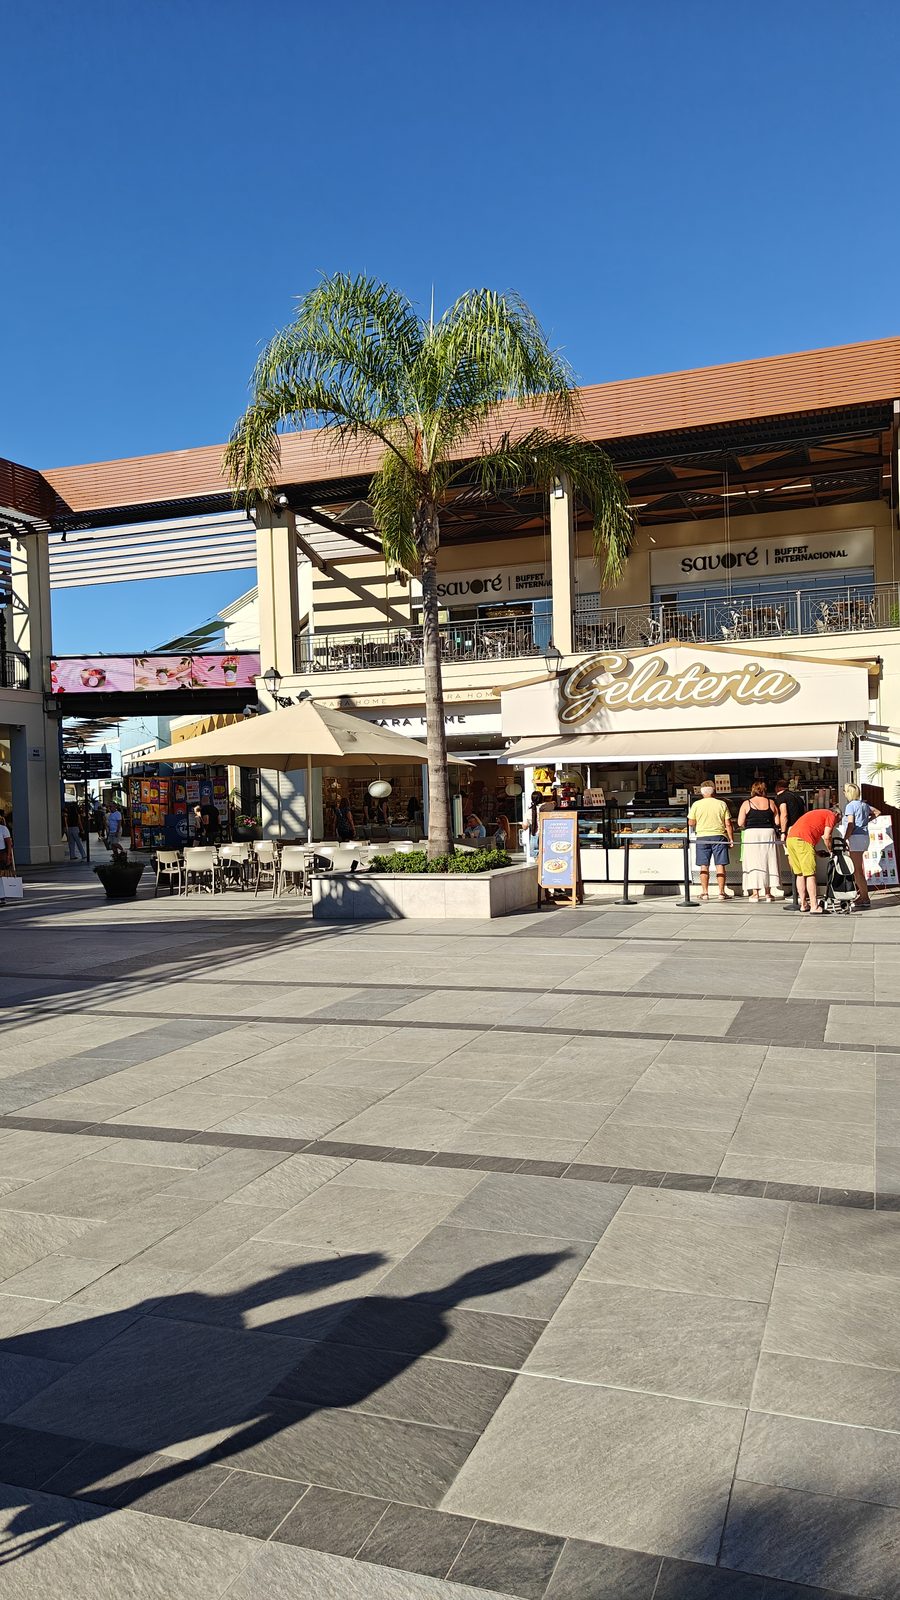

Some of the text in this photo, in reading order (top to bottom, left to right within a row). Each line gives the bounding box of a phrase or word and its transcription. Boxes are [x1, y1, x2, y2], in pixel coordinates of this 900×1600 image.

[774, 546, 808, 556] BUFFET
[774, 550, 848, 564] INTERNACIONAL
[681, 547, 759, 573] savoré
[515, 573, 545, 582] BUFFET
[436, 574, 502, 597] savoré
[558, 652, 800, 724] Gelateria
[421, 714, 467, 725] HME
